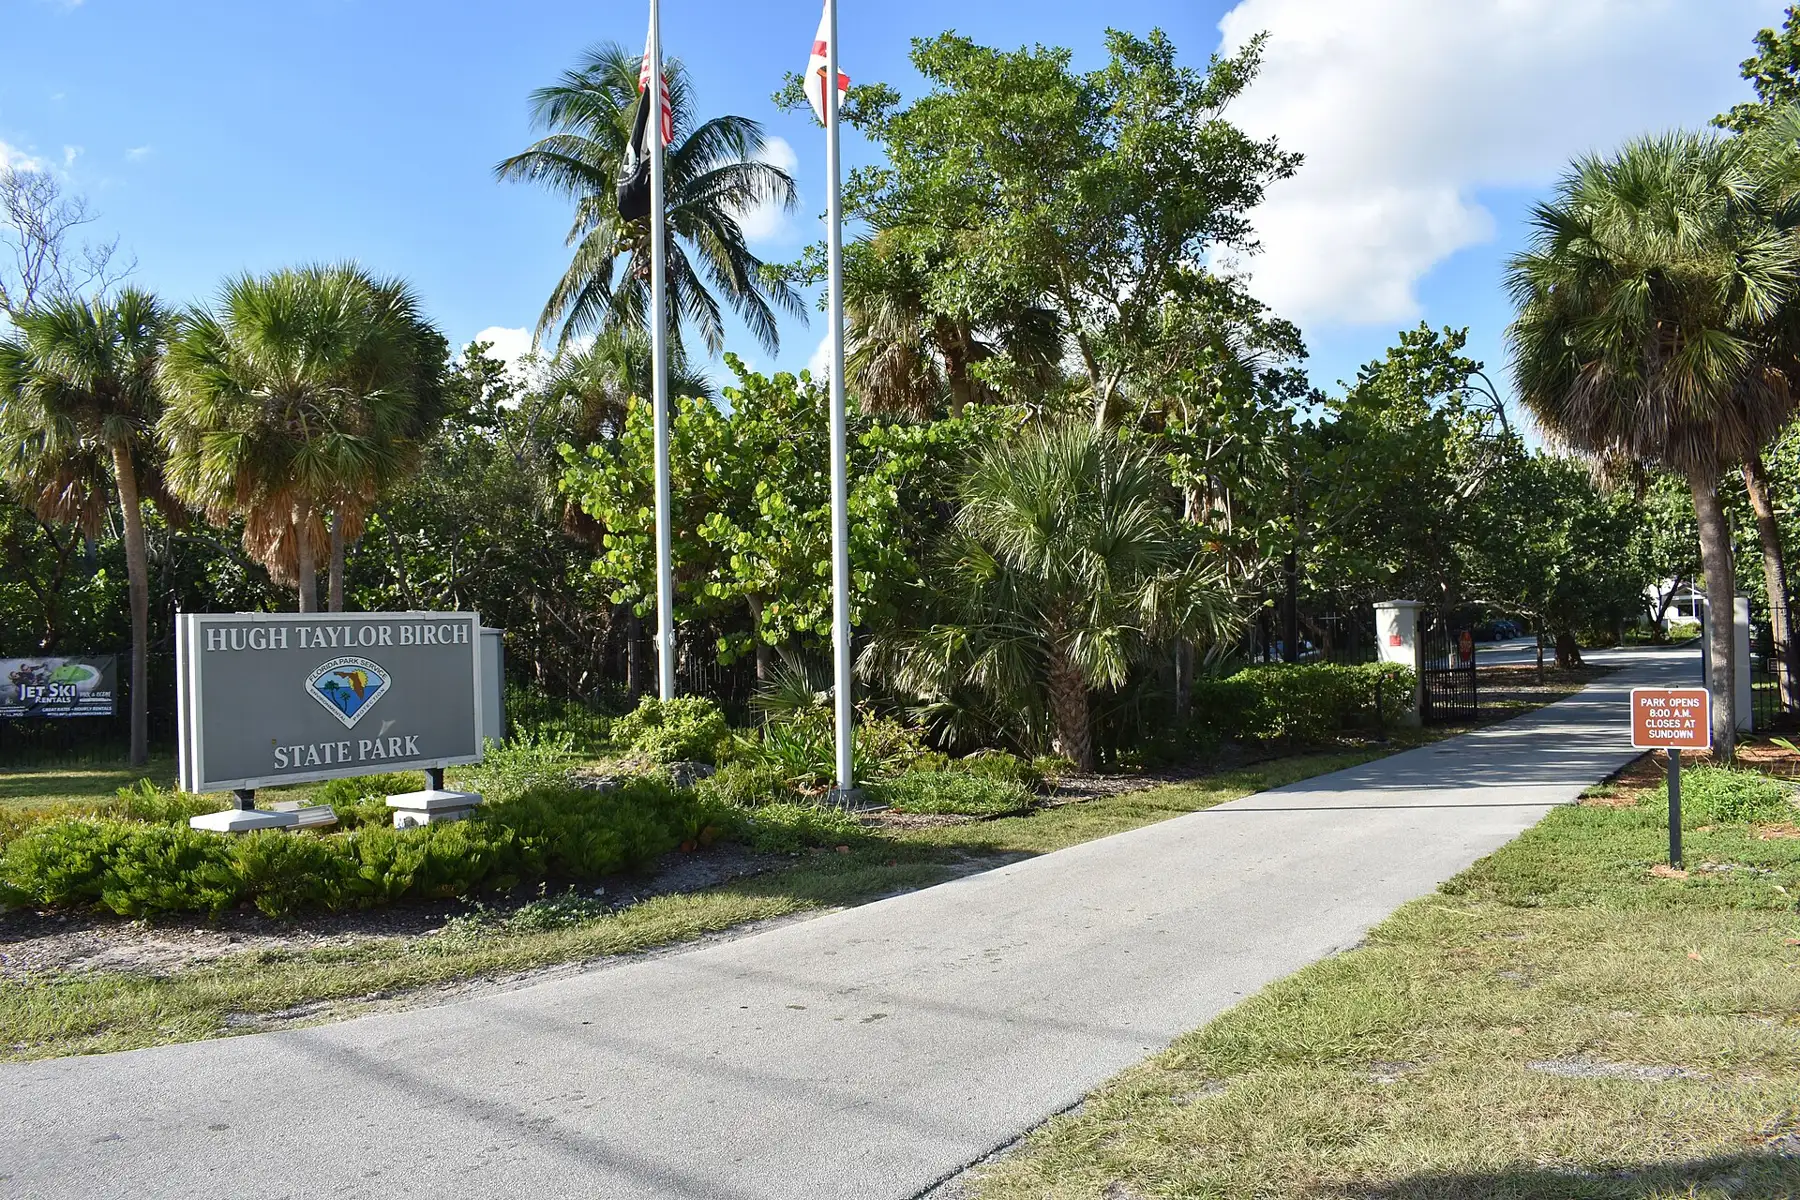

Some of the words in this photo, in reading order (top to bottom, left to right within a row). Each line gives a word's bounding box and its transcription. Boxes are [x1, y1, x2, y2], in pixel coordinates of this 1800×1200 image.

[207, 627, 288, 651] HUGH
[295, 625, 393, 649] TAYLOR
[399, 624, 469, 647] BIRCH
[309, 660, 339, 682] FLORIDA
[360, 660, 388, 680] SERVICE
[20, 684, 45, 700] JET
[49, 683, 76, 697] SKI
[310, 688, 346, 721] ENVIRONMENTAL
[353, 688, 385, 721] PROTECTION
[1640, 698, 1666, 707] PARK
[1669, 698, 1700, 707] OPENS
[1649, 709, 1670, 718] 8:00
[1673, 709, 1692, 718] A.M.
[1645, 719, 1680, 728] CLOSES
[1684, 719, 1696, 728] AT
[1649, 730, 1694, 739] SUNDOWN
[273, 740, 352, 769] STATE
[358, 735, 420, 761] PARK
